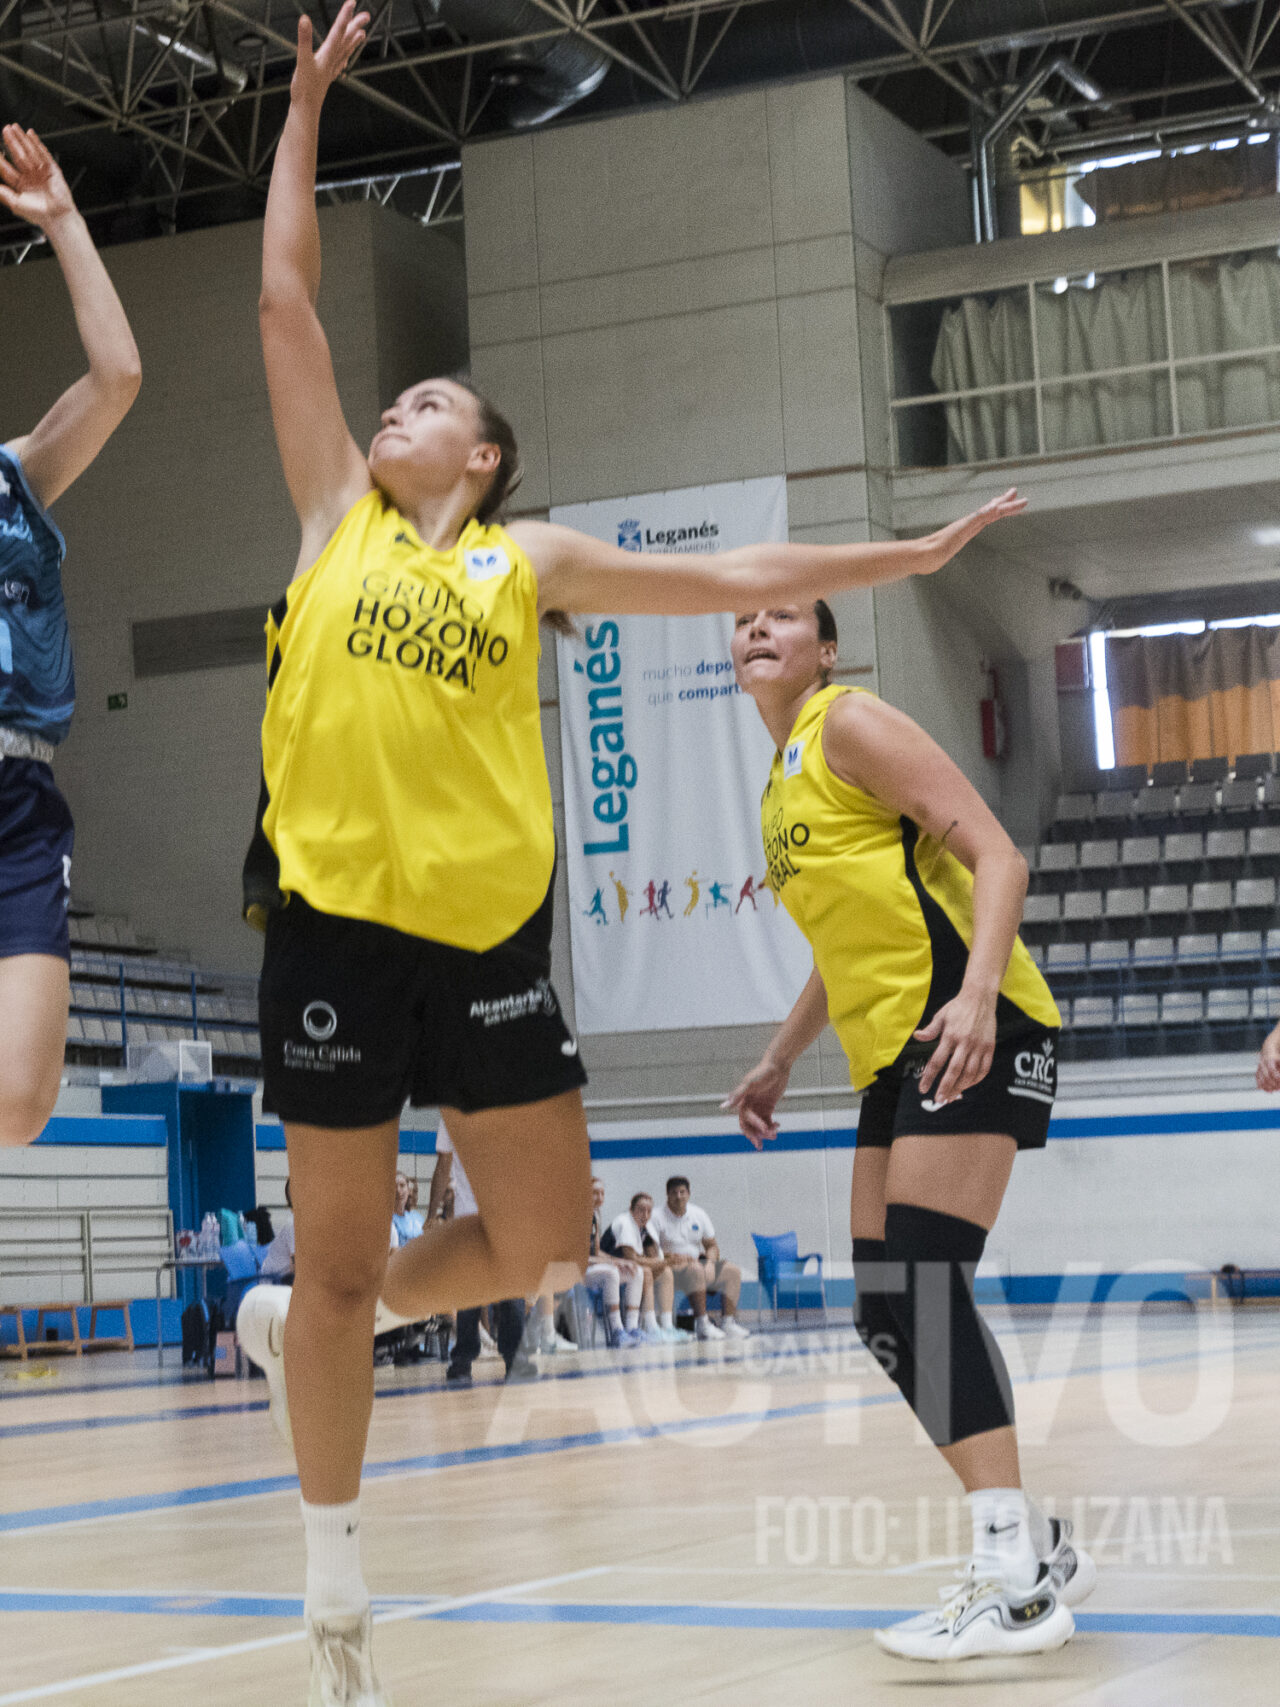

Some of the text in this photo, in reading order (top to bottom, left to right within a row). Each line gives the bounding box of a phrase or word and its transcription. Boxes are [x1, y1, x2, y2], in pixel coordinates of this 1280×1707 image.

[645, 520, 719, 545] Leganés
[353, 597, 509, 667] HOZONO
[696, 659, 734, 677] depo
[648, 682, 741, 707] que compart
[574, 620, 638, 857] Leganés
